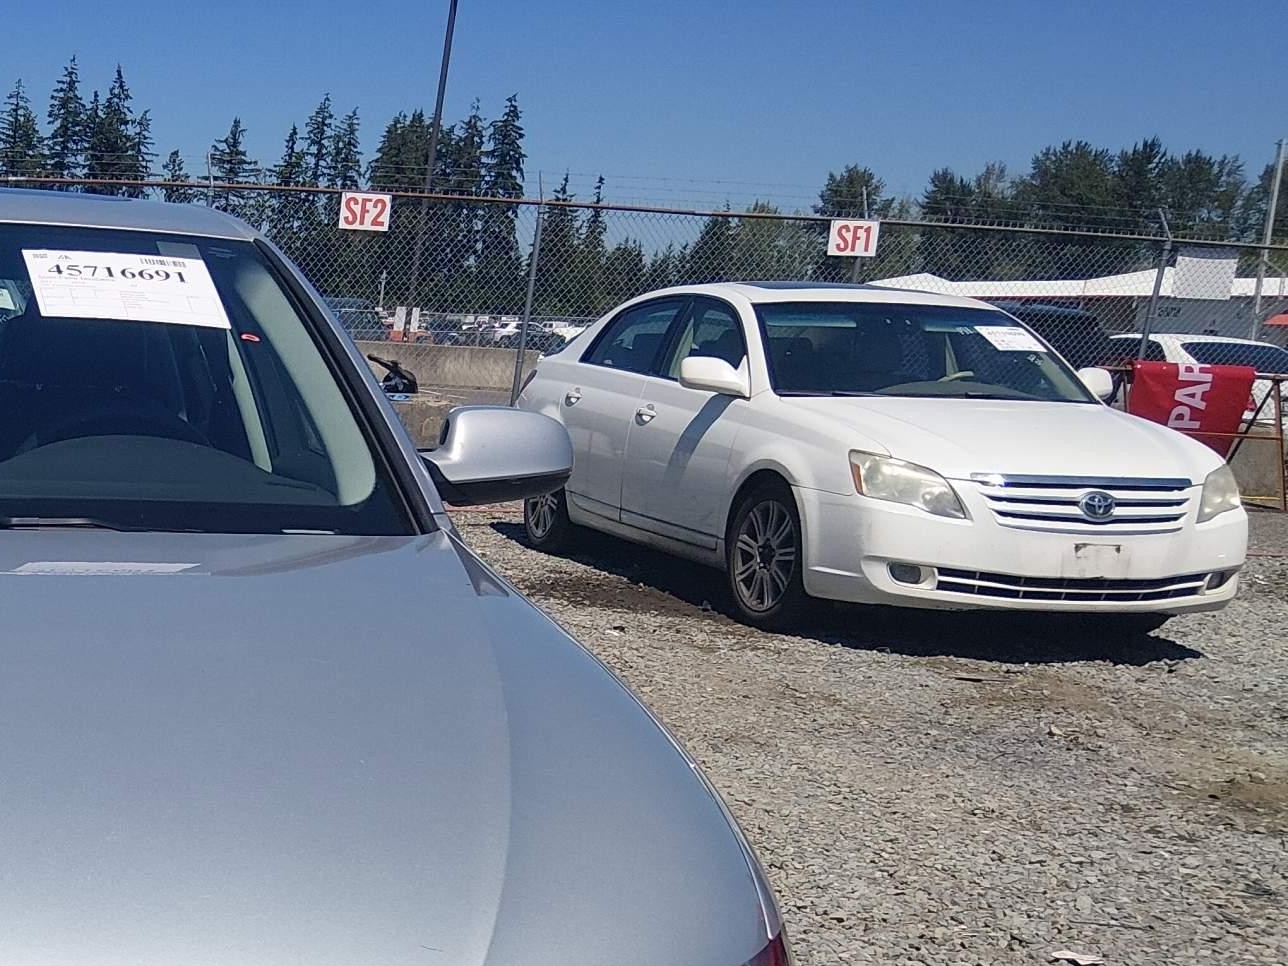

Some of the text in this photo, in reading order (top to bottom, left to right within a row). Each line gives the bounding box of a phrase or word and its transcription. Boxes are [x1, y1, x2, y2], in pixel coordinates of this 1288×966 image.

[343, 197, 387, 227] SF2
[835, 225, 872, 252] SF1
[46, 262, 187, 284] 45716691
